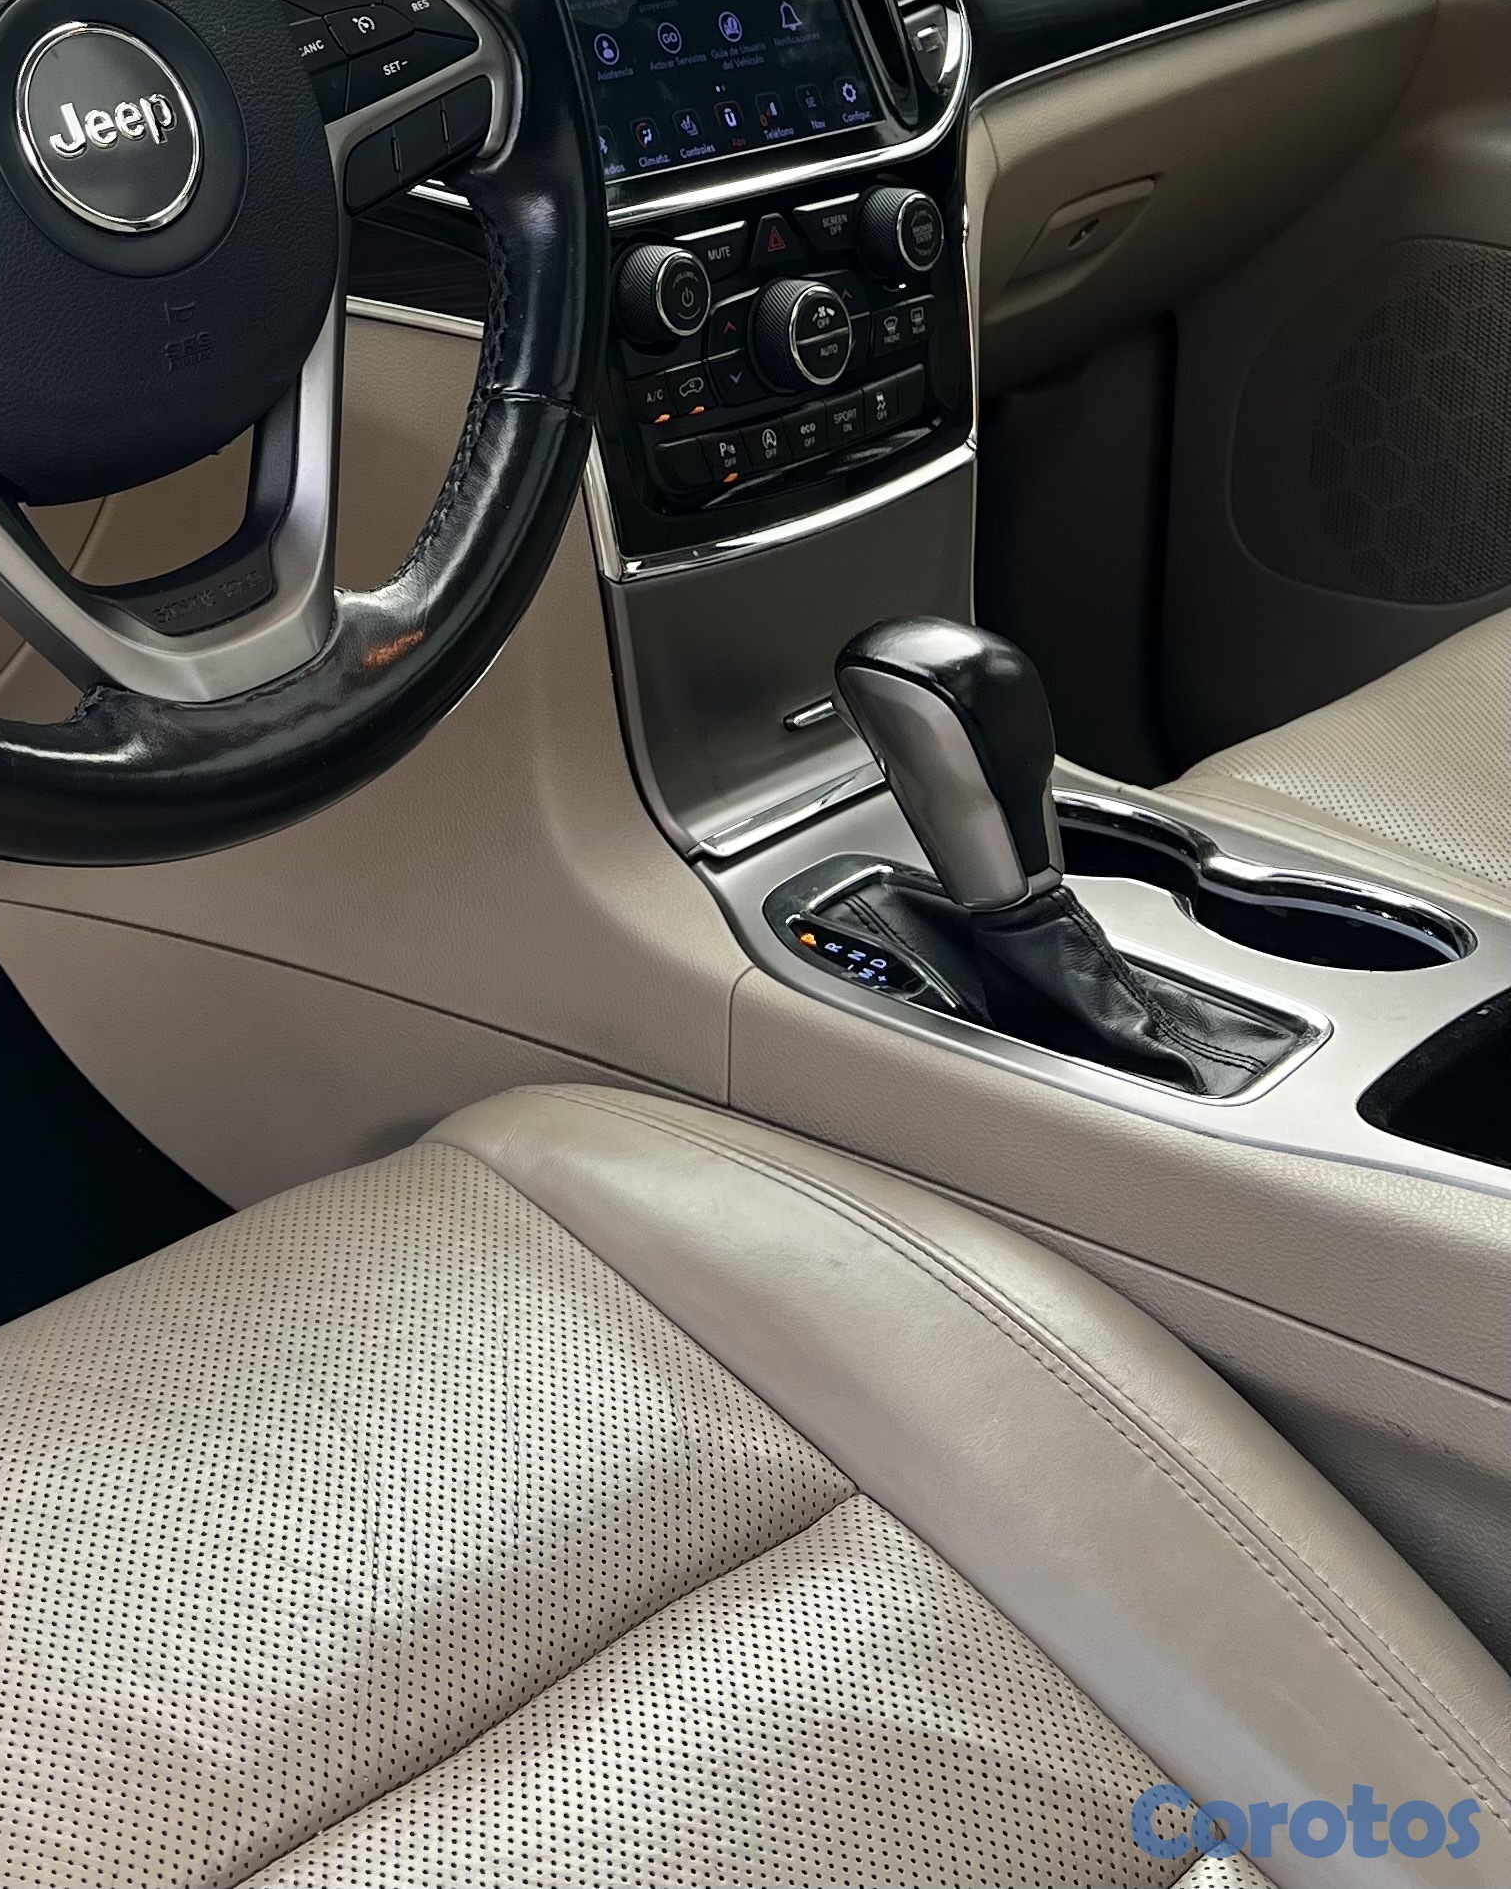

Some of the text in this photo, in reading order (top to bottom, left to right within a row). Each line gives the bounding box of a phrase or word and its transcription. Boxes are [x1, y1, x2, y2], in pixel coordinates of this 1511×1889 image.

[661, 32, 678, 46] GO
[49, 93, 178, 159] Jeep
[604, 162, 626, 176] edios
[708, 245, 731, 261] MUTE
[816, 316, 830, 329] OFF
[820, 343, 839, 358] AUTO
[647, 390, 664, 403] A/C
[833, 408, 858, 424] SPORT
[800, 422, 817, 435] eco
[824, 942, 843, 953] R
[869, 958, 887, 970] D
